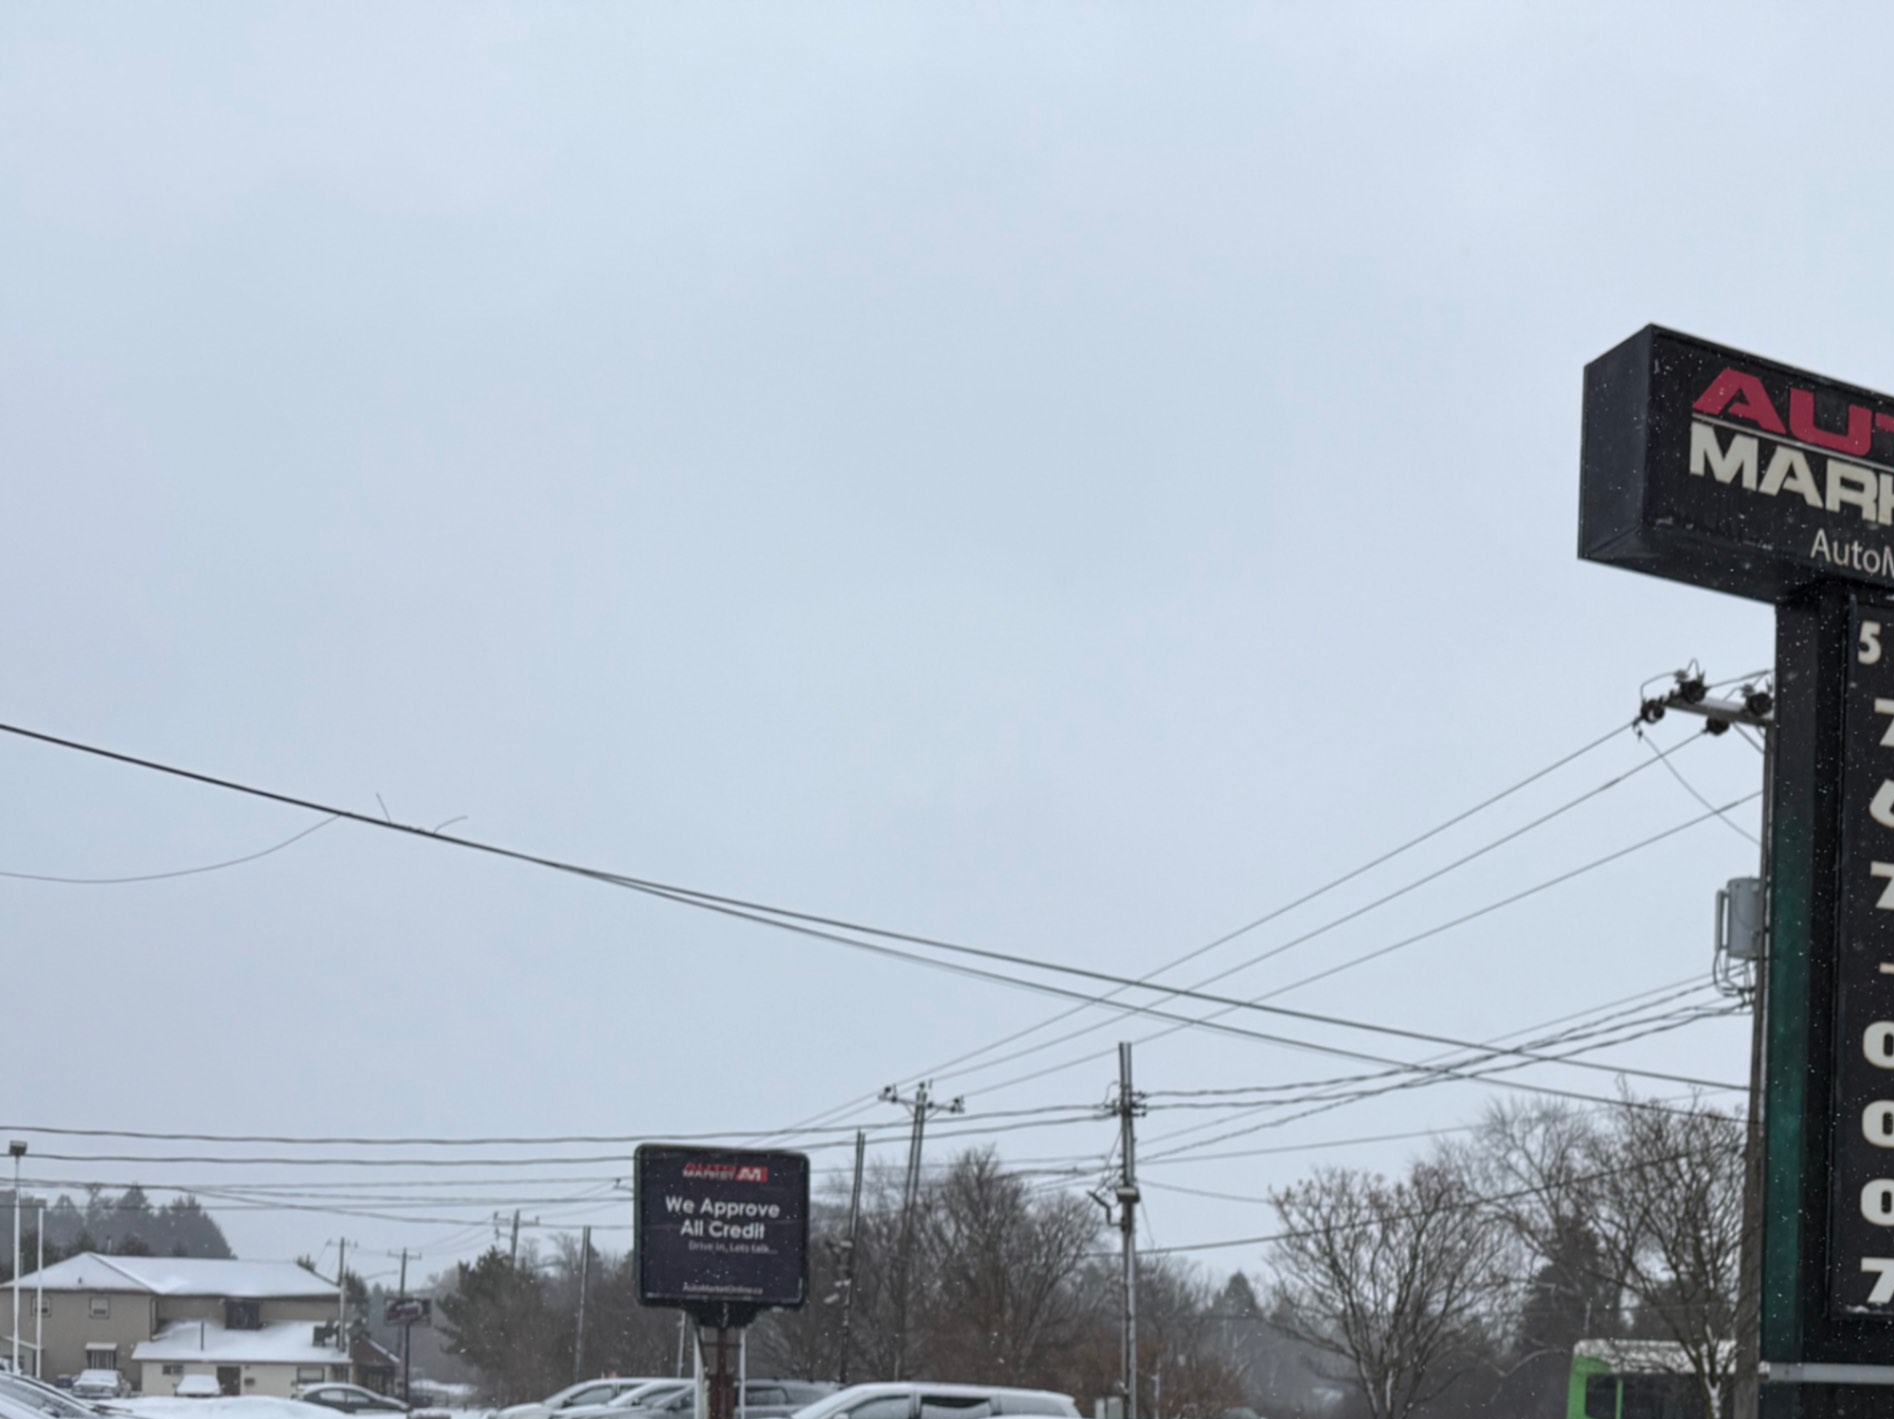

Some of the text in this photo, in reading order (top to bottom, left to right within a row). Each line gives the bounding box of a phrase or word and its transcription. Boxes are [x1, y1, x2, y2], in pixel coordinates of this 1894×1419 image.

[665, 1195, 780, 1219] We Approve
[680, 1218, 765, 1239] All Credit
